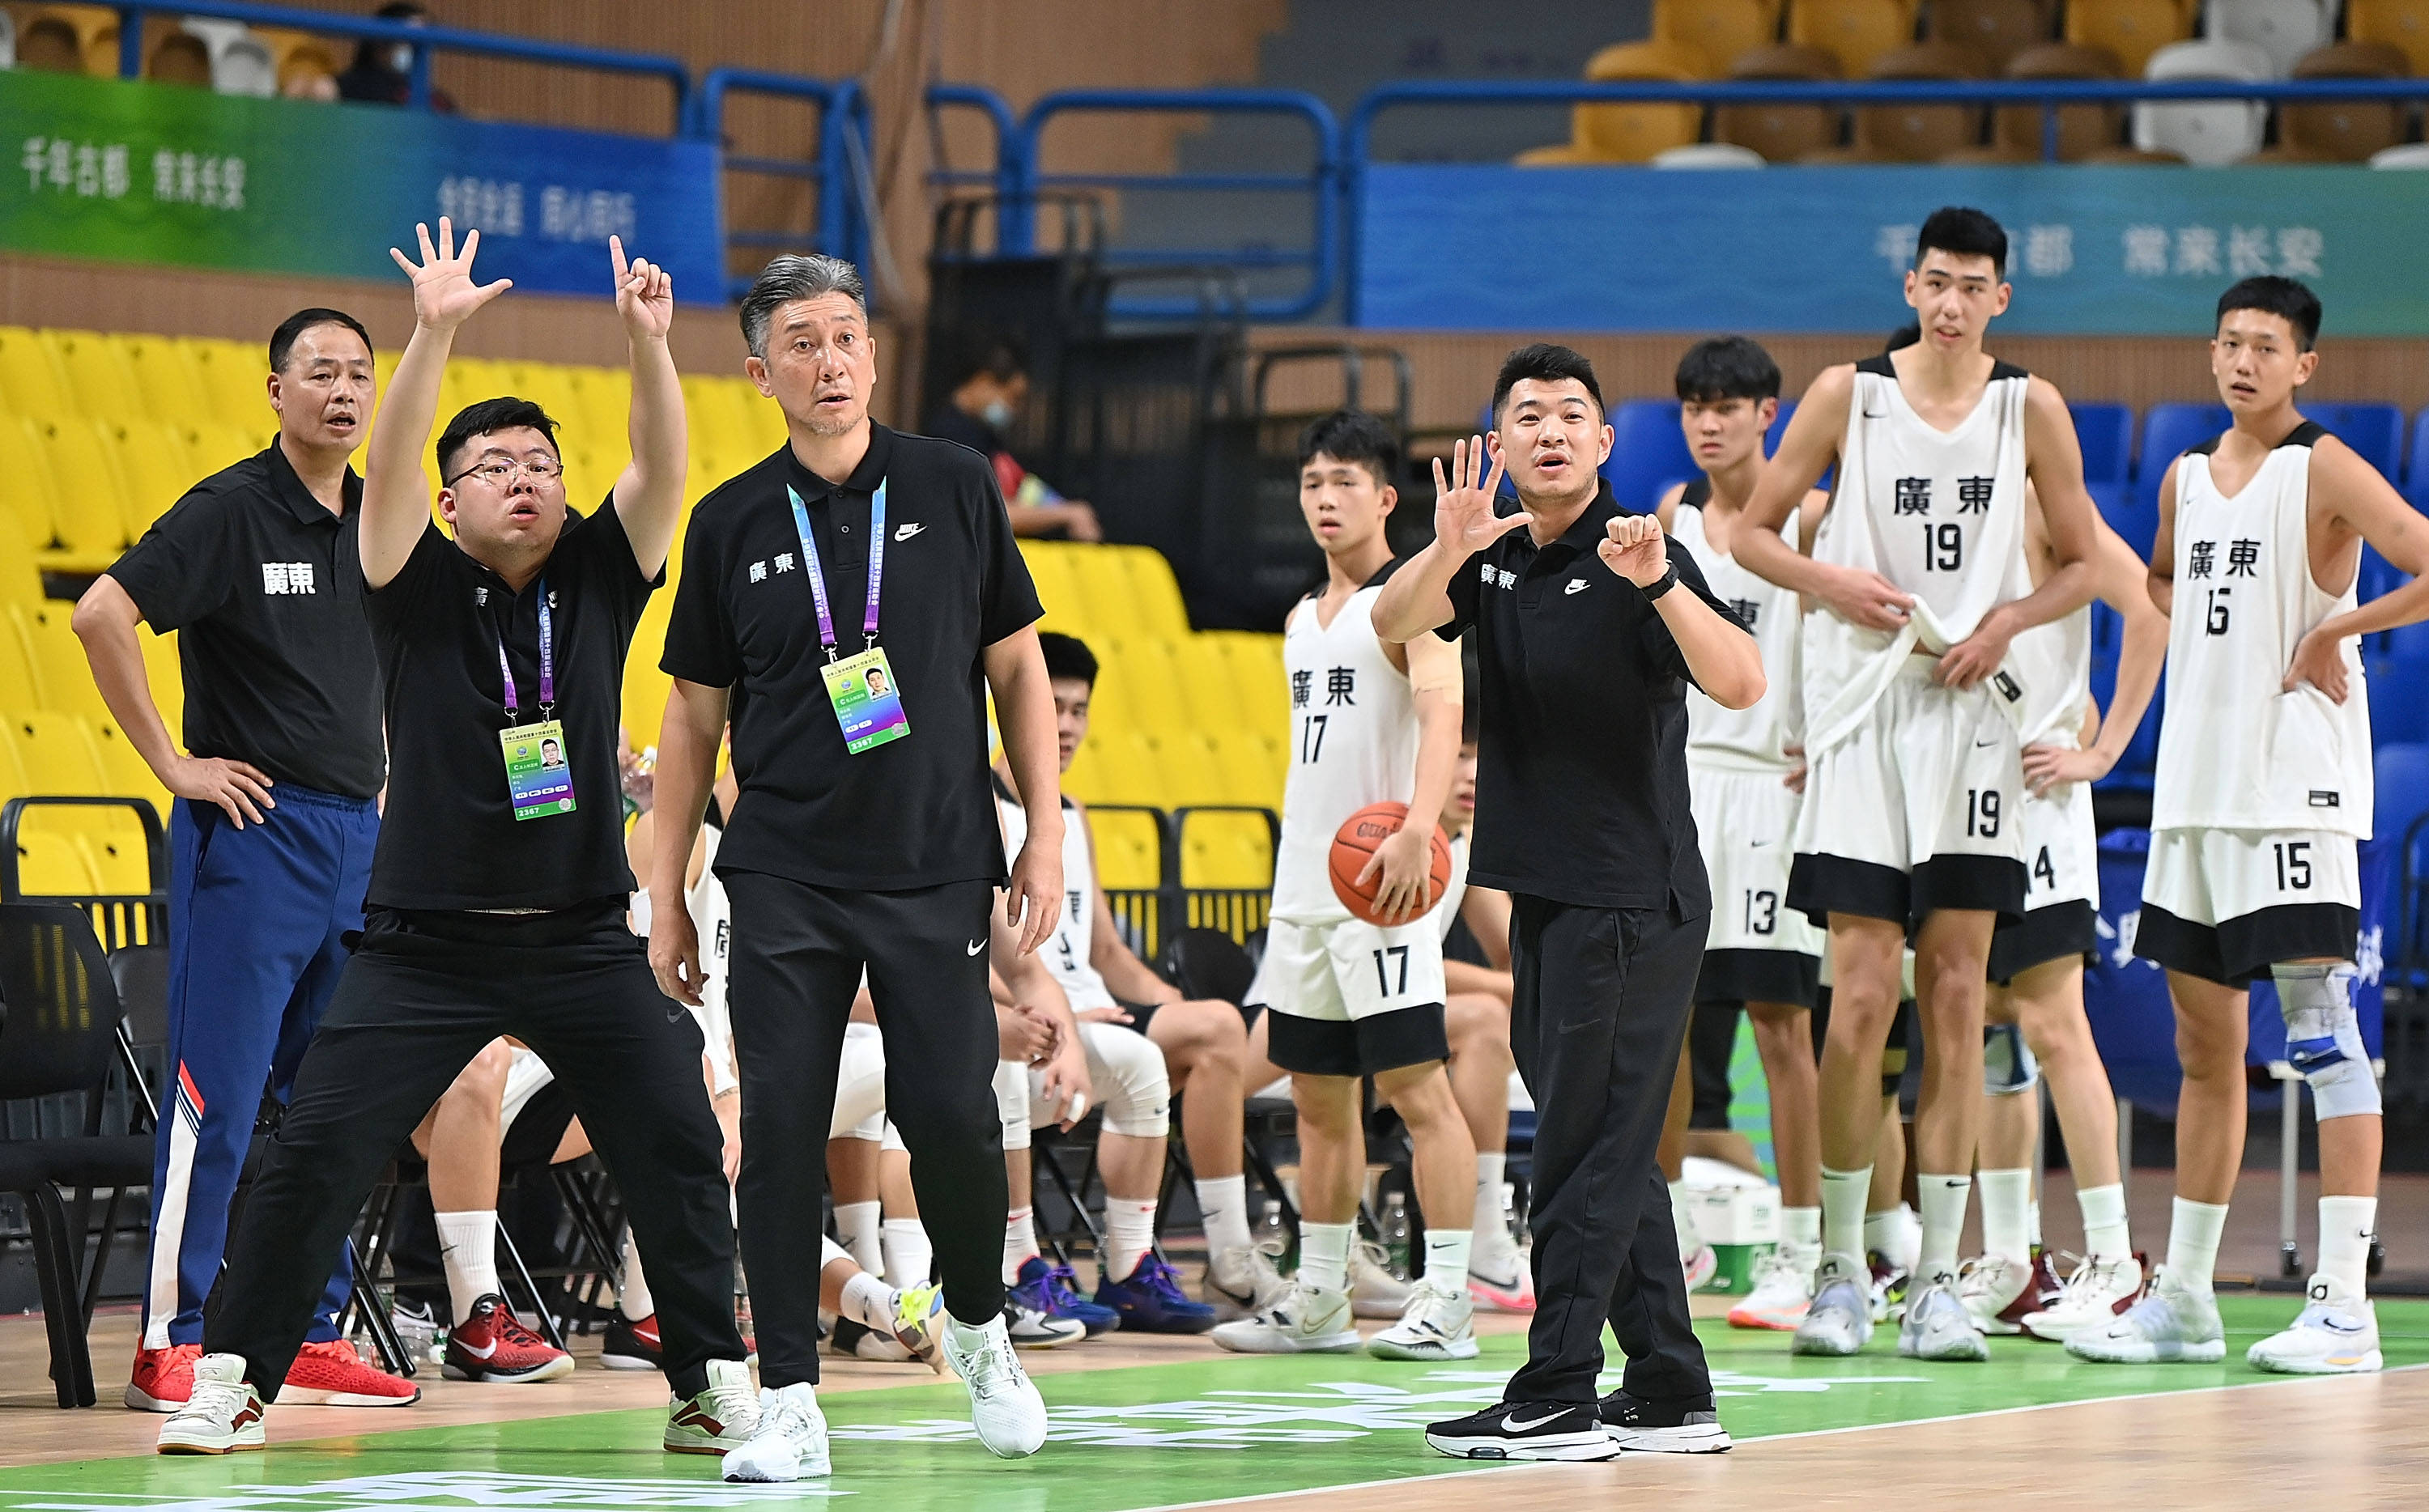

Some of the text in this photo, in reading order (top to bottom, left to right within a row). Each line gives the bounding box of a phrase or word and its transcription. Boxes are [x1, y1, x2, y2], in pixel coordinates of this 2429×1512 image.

[1872, 223, 2074, 278] 千都
[1895, 475, 1995, 516] 廣東
[749, 552, 795, 584] 廣東
[1925, 524, 1962, 571] 19
[2189, 538, 2261, 580] 廣東
[262, 562, 316, 595] 廣東
[1481, 563, 1517, 590] 廣東
[1292, 665, 1357, 709] 廣東
[1303, 715, 1329, 764] 17
[518, 807, 540, 818] 2367
[1967, 788, 2001, 838] 19
[2274, 842, 2312, 890] 15
[1745, 889, 1777, 936] 13
[1373, 945, 1410, 998] 17
